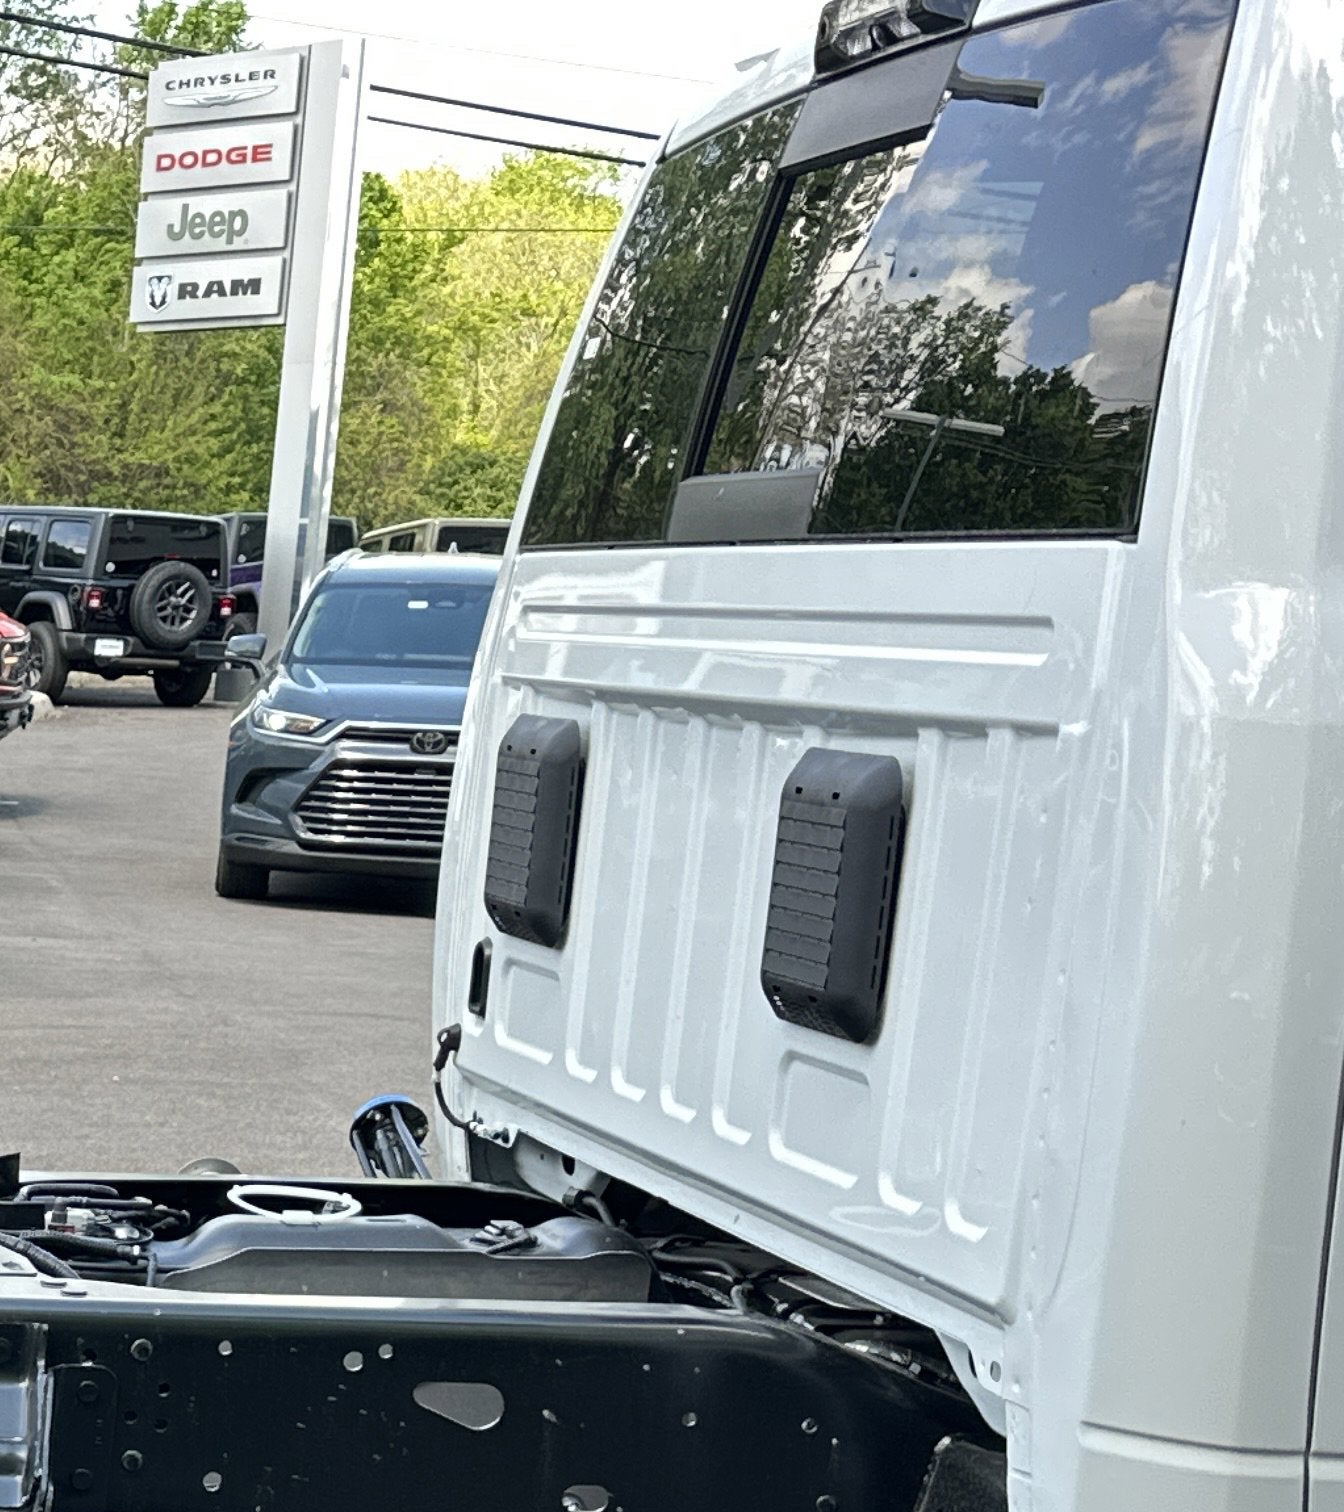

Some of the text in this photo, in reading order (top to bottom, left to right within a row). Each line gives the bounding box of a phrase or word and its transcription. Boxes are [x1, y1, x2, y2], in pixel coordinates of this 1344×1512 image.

[164, 68, 277, 91] CHRYSLER
[155, 143, 273, 172] DODGE
[166, 203, 249, 245] Jeep
[177, 277, 262, 300] RAM
